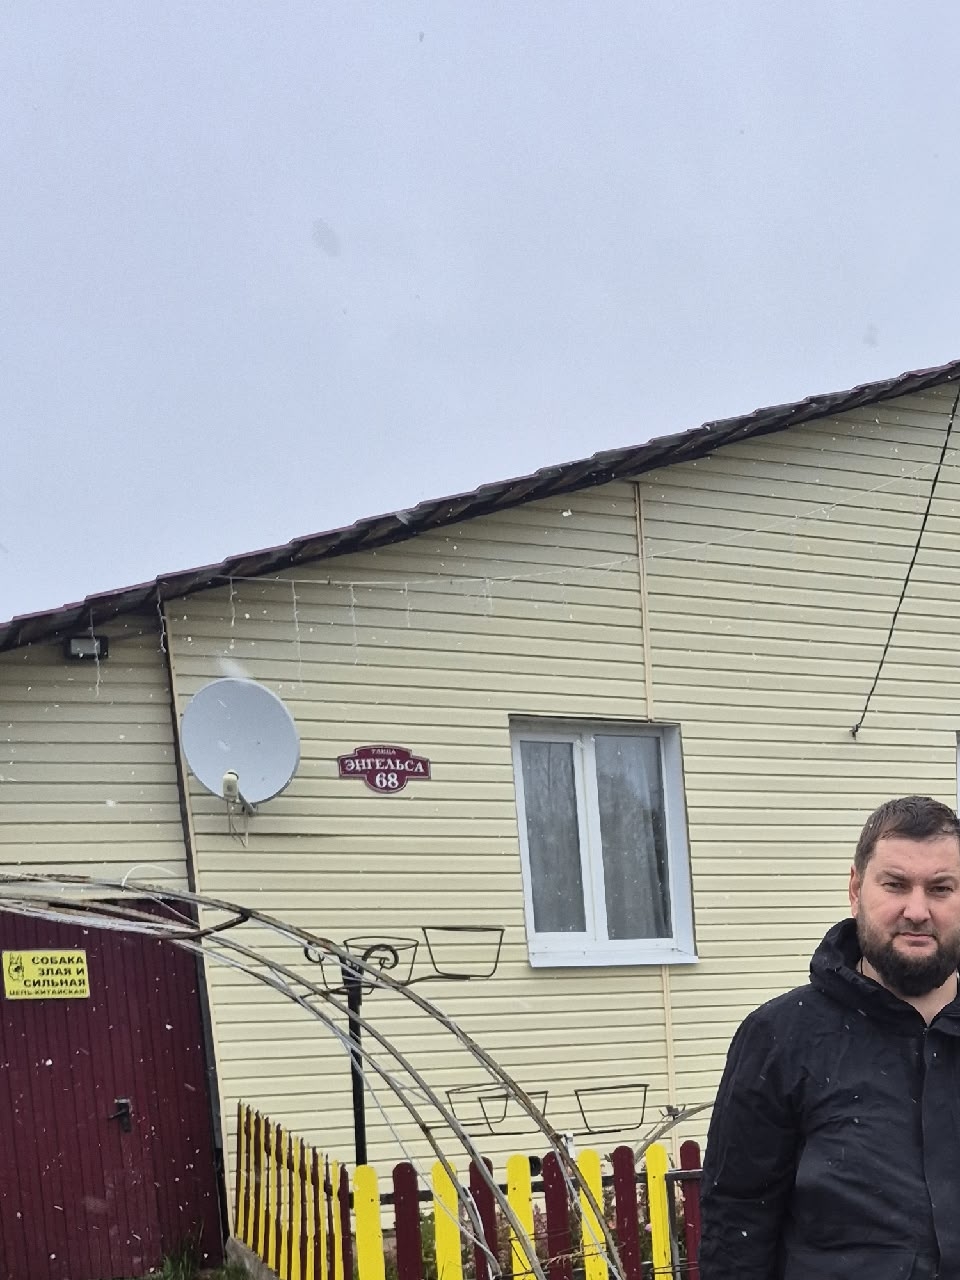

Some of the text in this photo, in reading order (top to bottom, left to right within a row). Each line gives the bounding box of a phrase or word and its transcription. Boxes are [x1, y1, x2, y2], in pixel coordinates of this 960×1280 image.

[344, 758, 425, 773] ЭНГЕЛЬСА
[375, 771, 399, 788] 68
[31, 956, 84, 965] СОБАКА
[38, 967, 85, 976] ЗЛАЯ И
[23, 979, 86, 988] СИЛЬНАЯ
